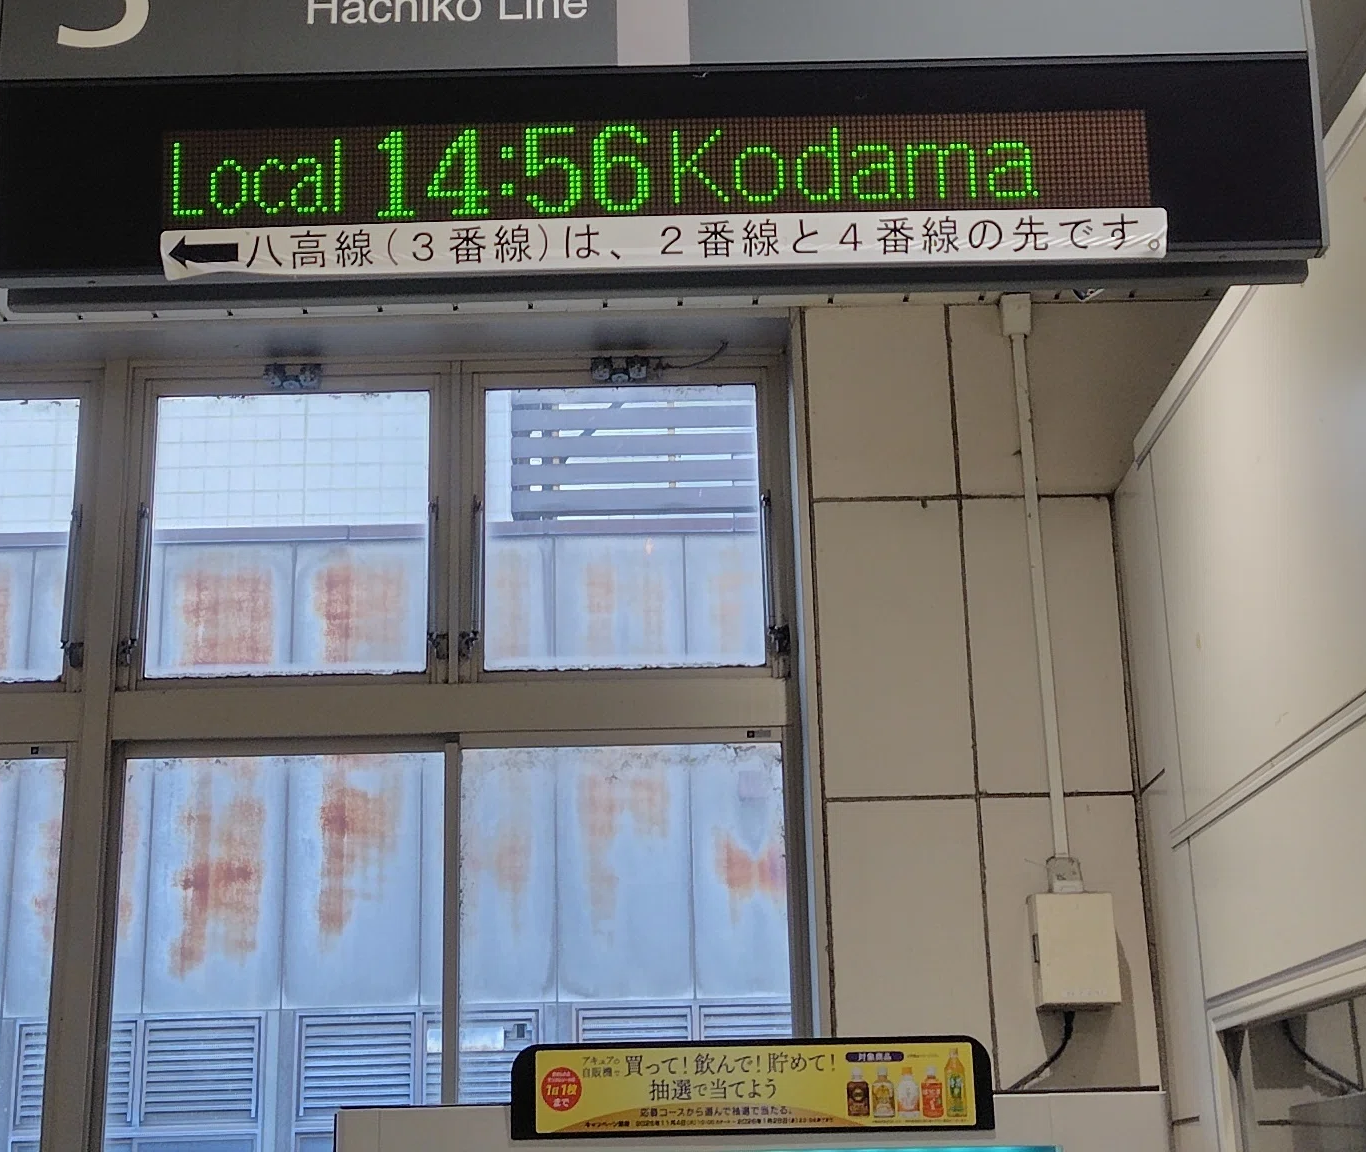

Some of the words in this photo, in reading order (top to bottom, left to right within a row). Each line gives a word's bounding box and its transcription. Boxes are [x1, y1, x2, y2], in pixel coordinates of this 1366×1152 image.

[171, 138, 341, 217] Local
[375, 124, 651, 218] 14:56
[671, 126, 1040, 205] Kodama
[649, 1077, 777, 1102] 抽選で当てよう
